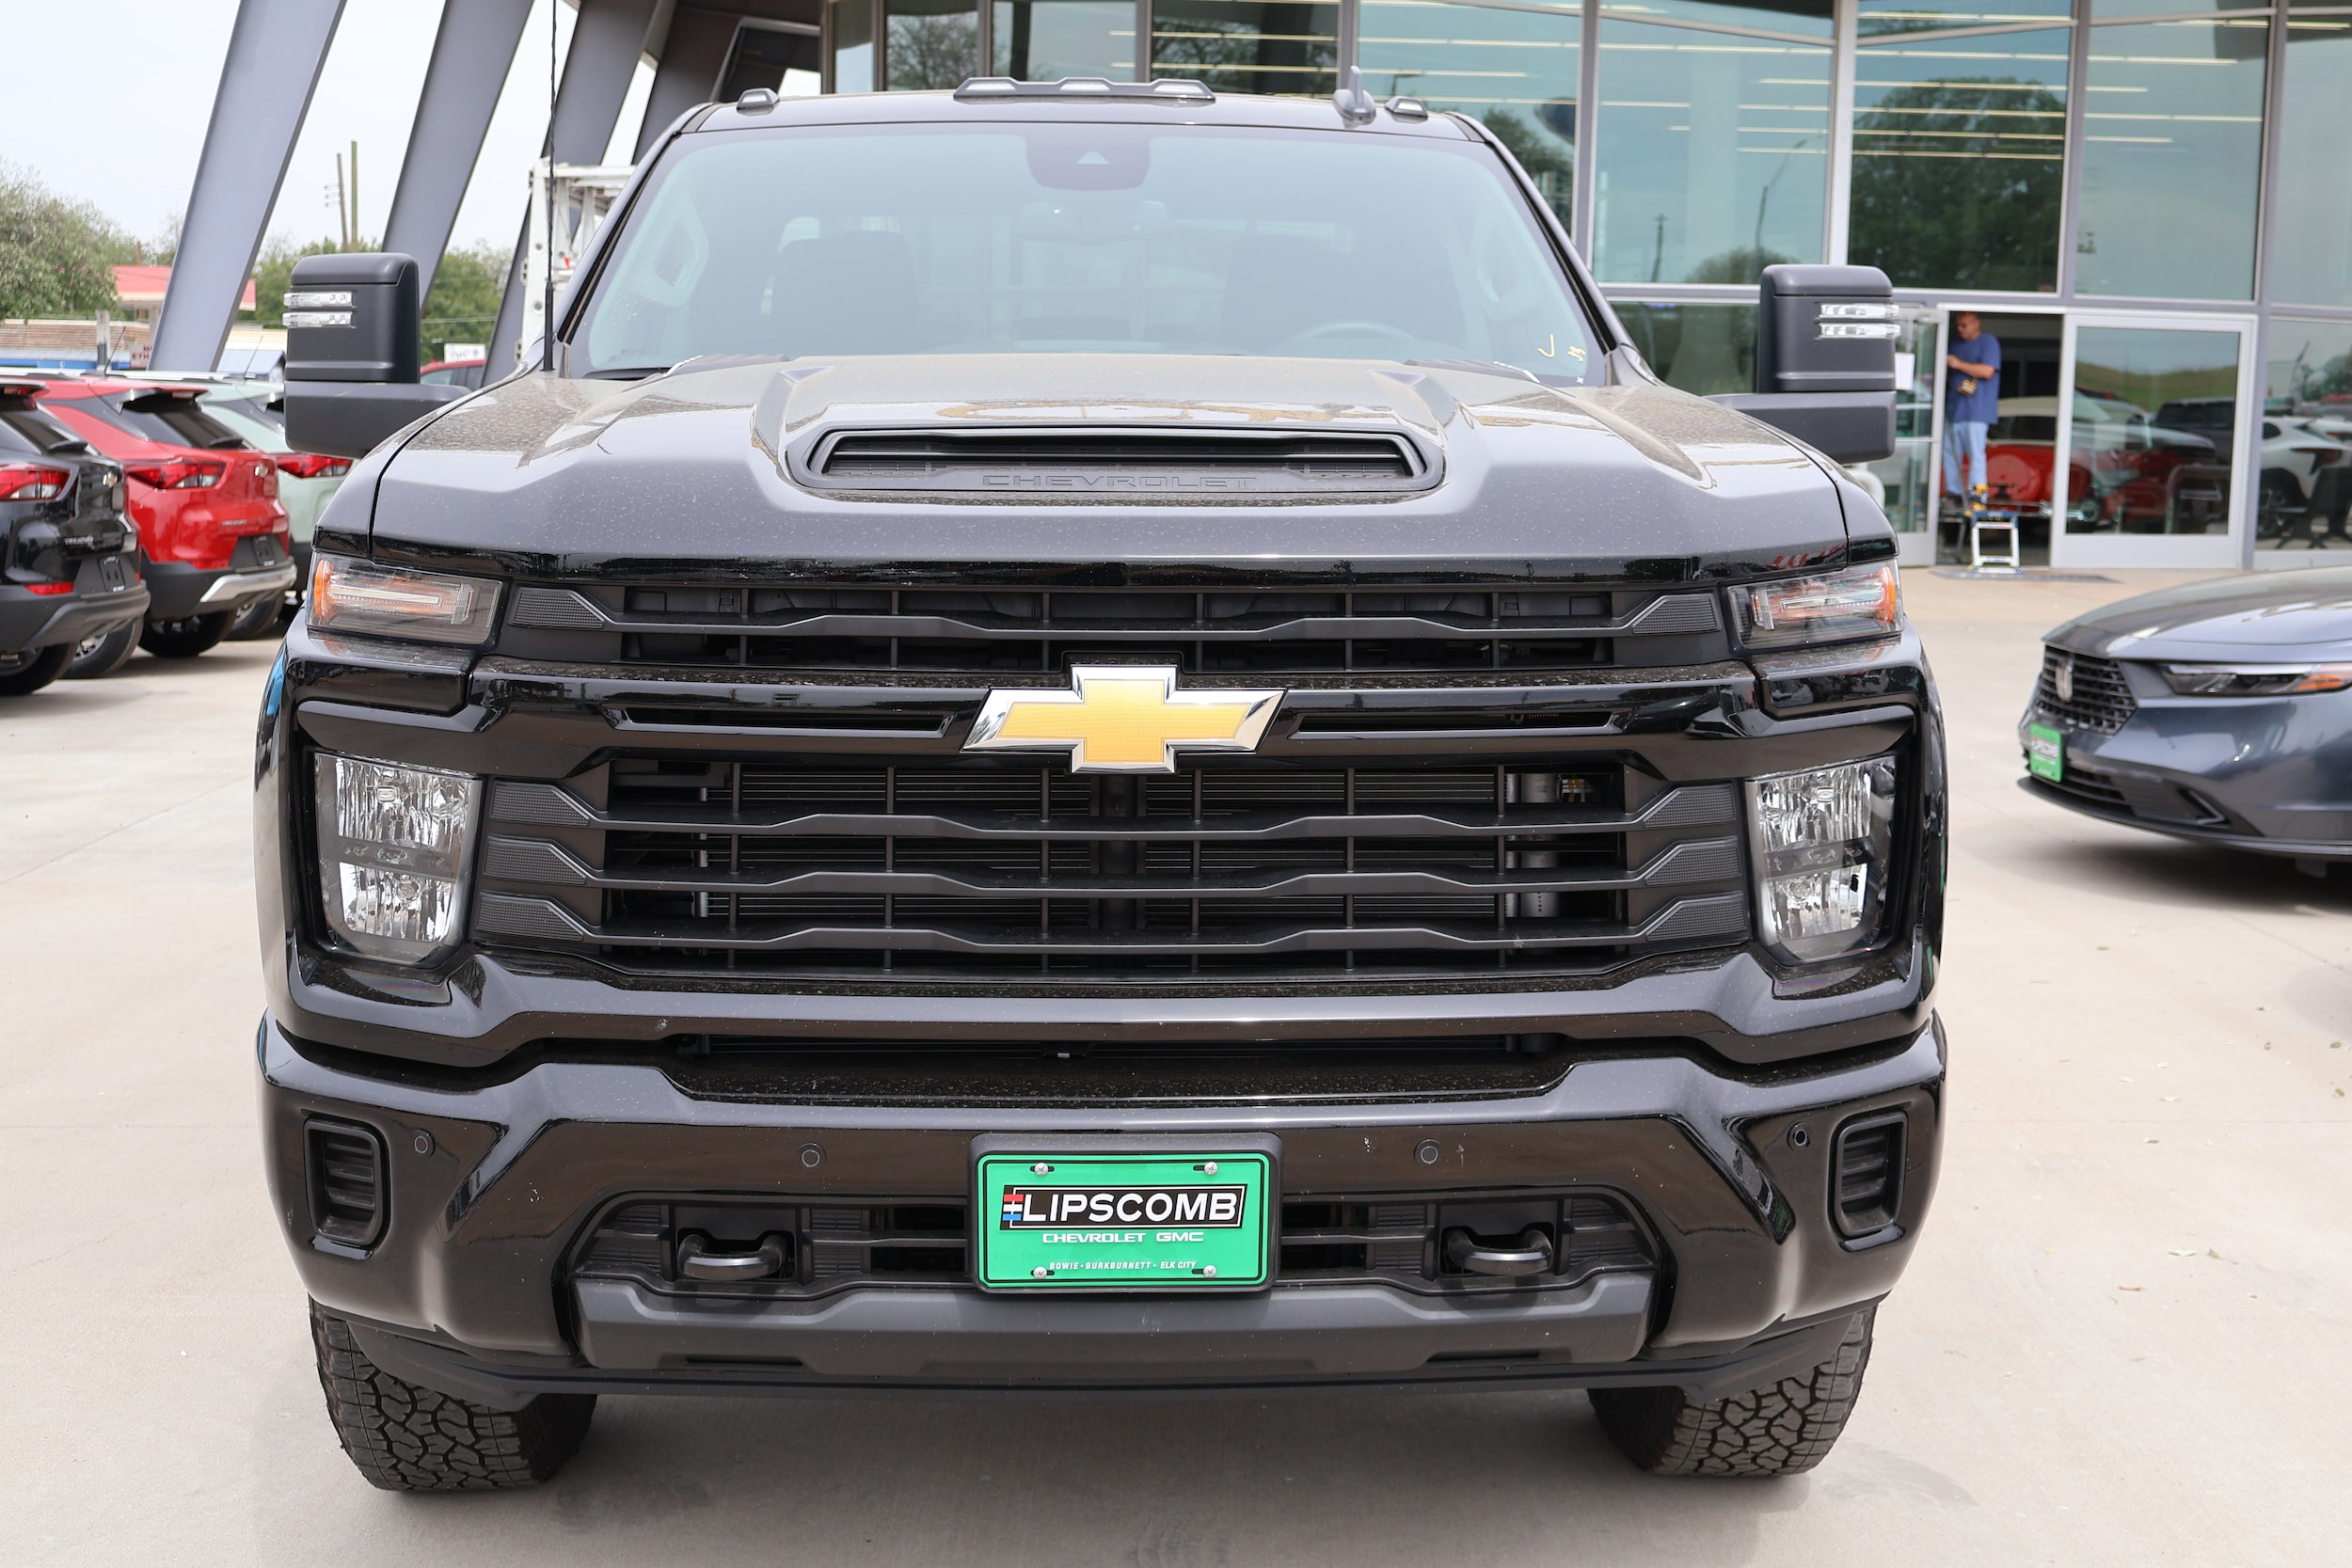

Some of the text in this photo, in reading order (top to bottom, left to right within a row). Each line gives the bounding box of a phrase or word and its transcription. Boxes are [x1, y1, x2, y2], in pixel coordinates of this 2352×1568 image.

[983, 475, 1257, 489] CHEVROLET
[1023, 1193, 1237, 1222] LIPSCOMB
[1041, 1231, 1204, 1243] CHEVROLET GMC
[1049, 1260, 1198, 1270] BOWIE BURKBURNETT ELK CITY
